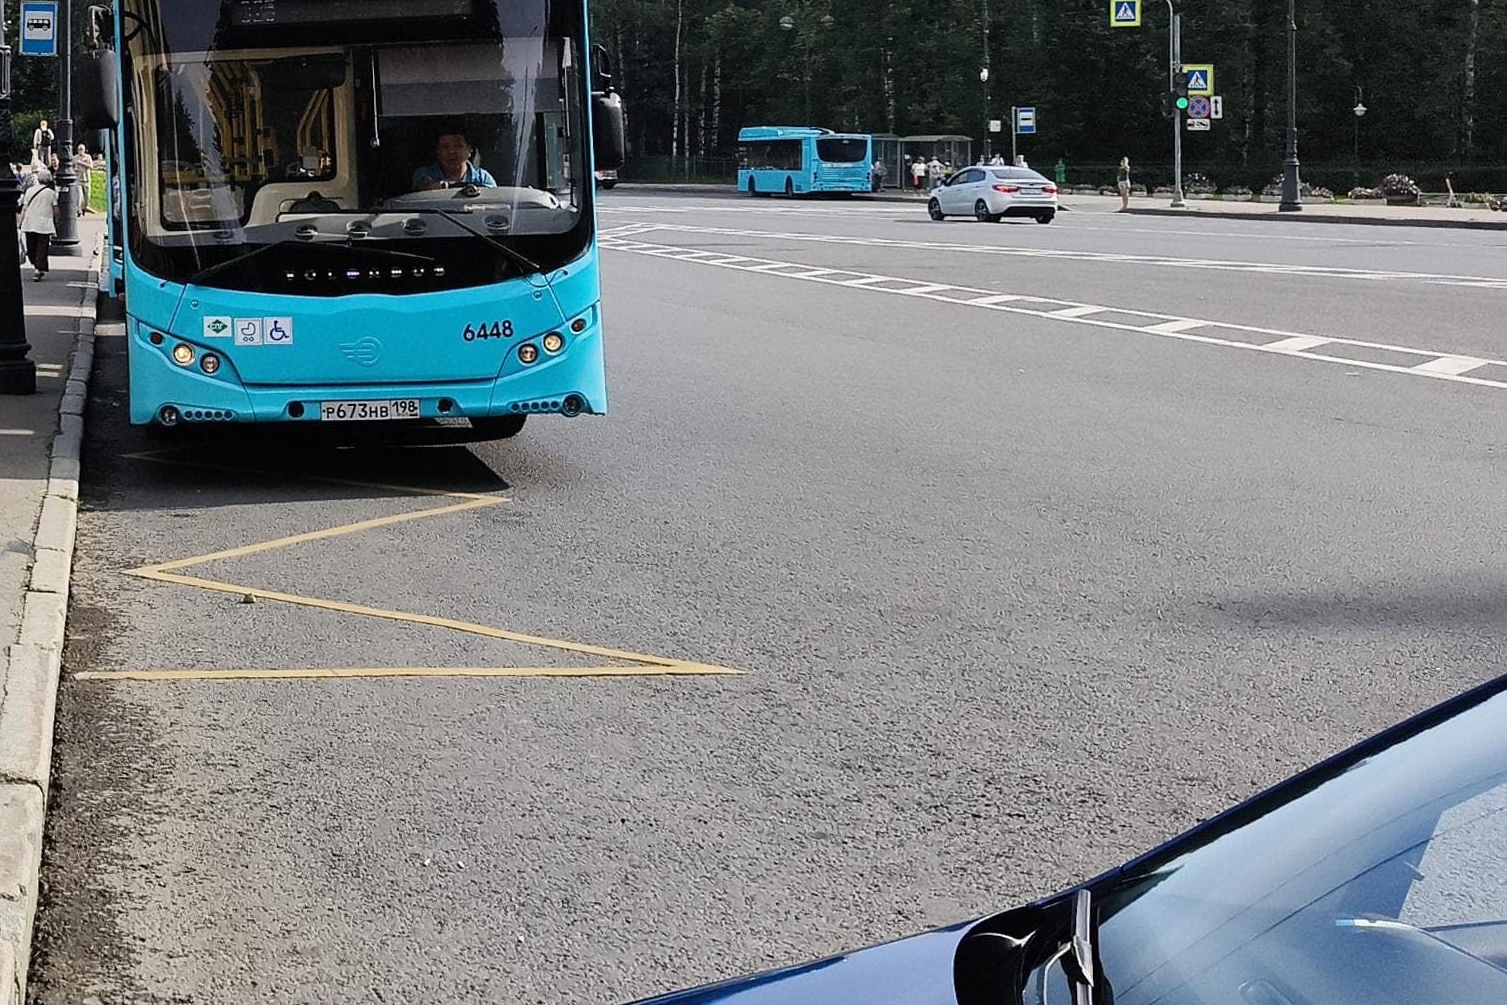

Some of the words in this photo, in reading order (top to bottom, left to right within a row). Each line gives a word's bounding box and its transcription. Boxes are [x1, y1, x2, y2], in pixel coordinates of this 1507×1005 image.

[463, 319, 514, 342] 6448
[326, 403, 389, 419] Р673НВ
[392, 401, 415, 414] 198
